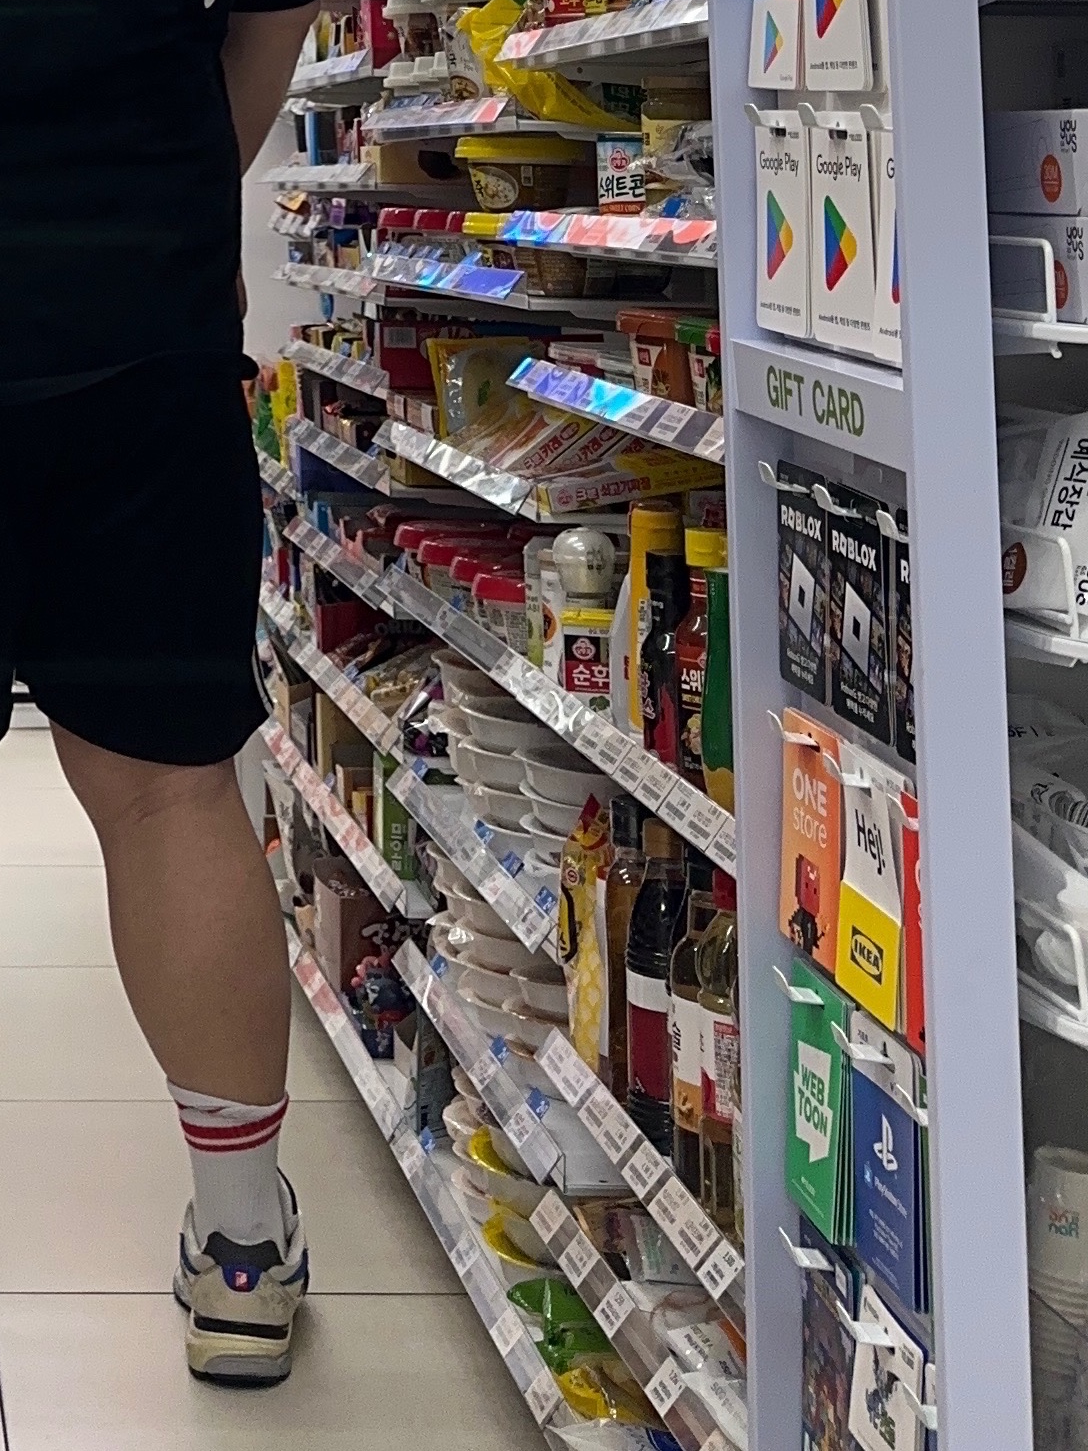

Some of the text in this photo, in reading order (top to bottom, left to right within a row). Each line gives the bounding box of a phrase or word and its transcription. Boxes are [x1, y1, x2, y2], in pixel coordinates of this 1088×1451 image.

[759, 150, 800, 177] Google Play
[816, 154, 844, 181] Google
[845, 156, 862, 182] Play
[767, 365, 865, 437] GIFT CARD
[780, 504, 822, 542] ROBLOX
[832, 529, 876, 571] ROBLOX
[792, 766, 828, 817] ONE
[792, 804, 828, 849] store
[855, 808, 886, 875] Hej!
[852, 940, 882, 975] IKEA
[801, 1064, 825, 1108] WEB
[797, 1085, 828, 1138] TOON
